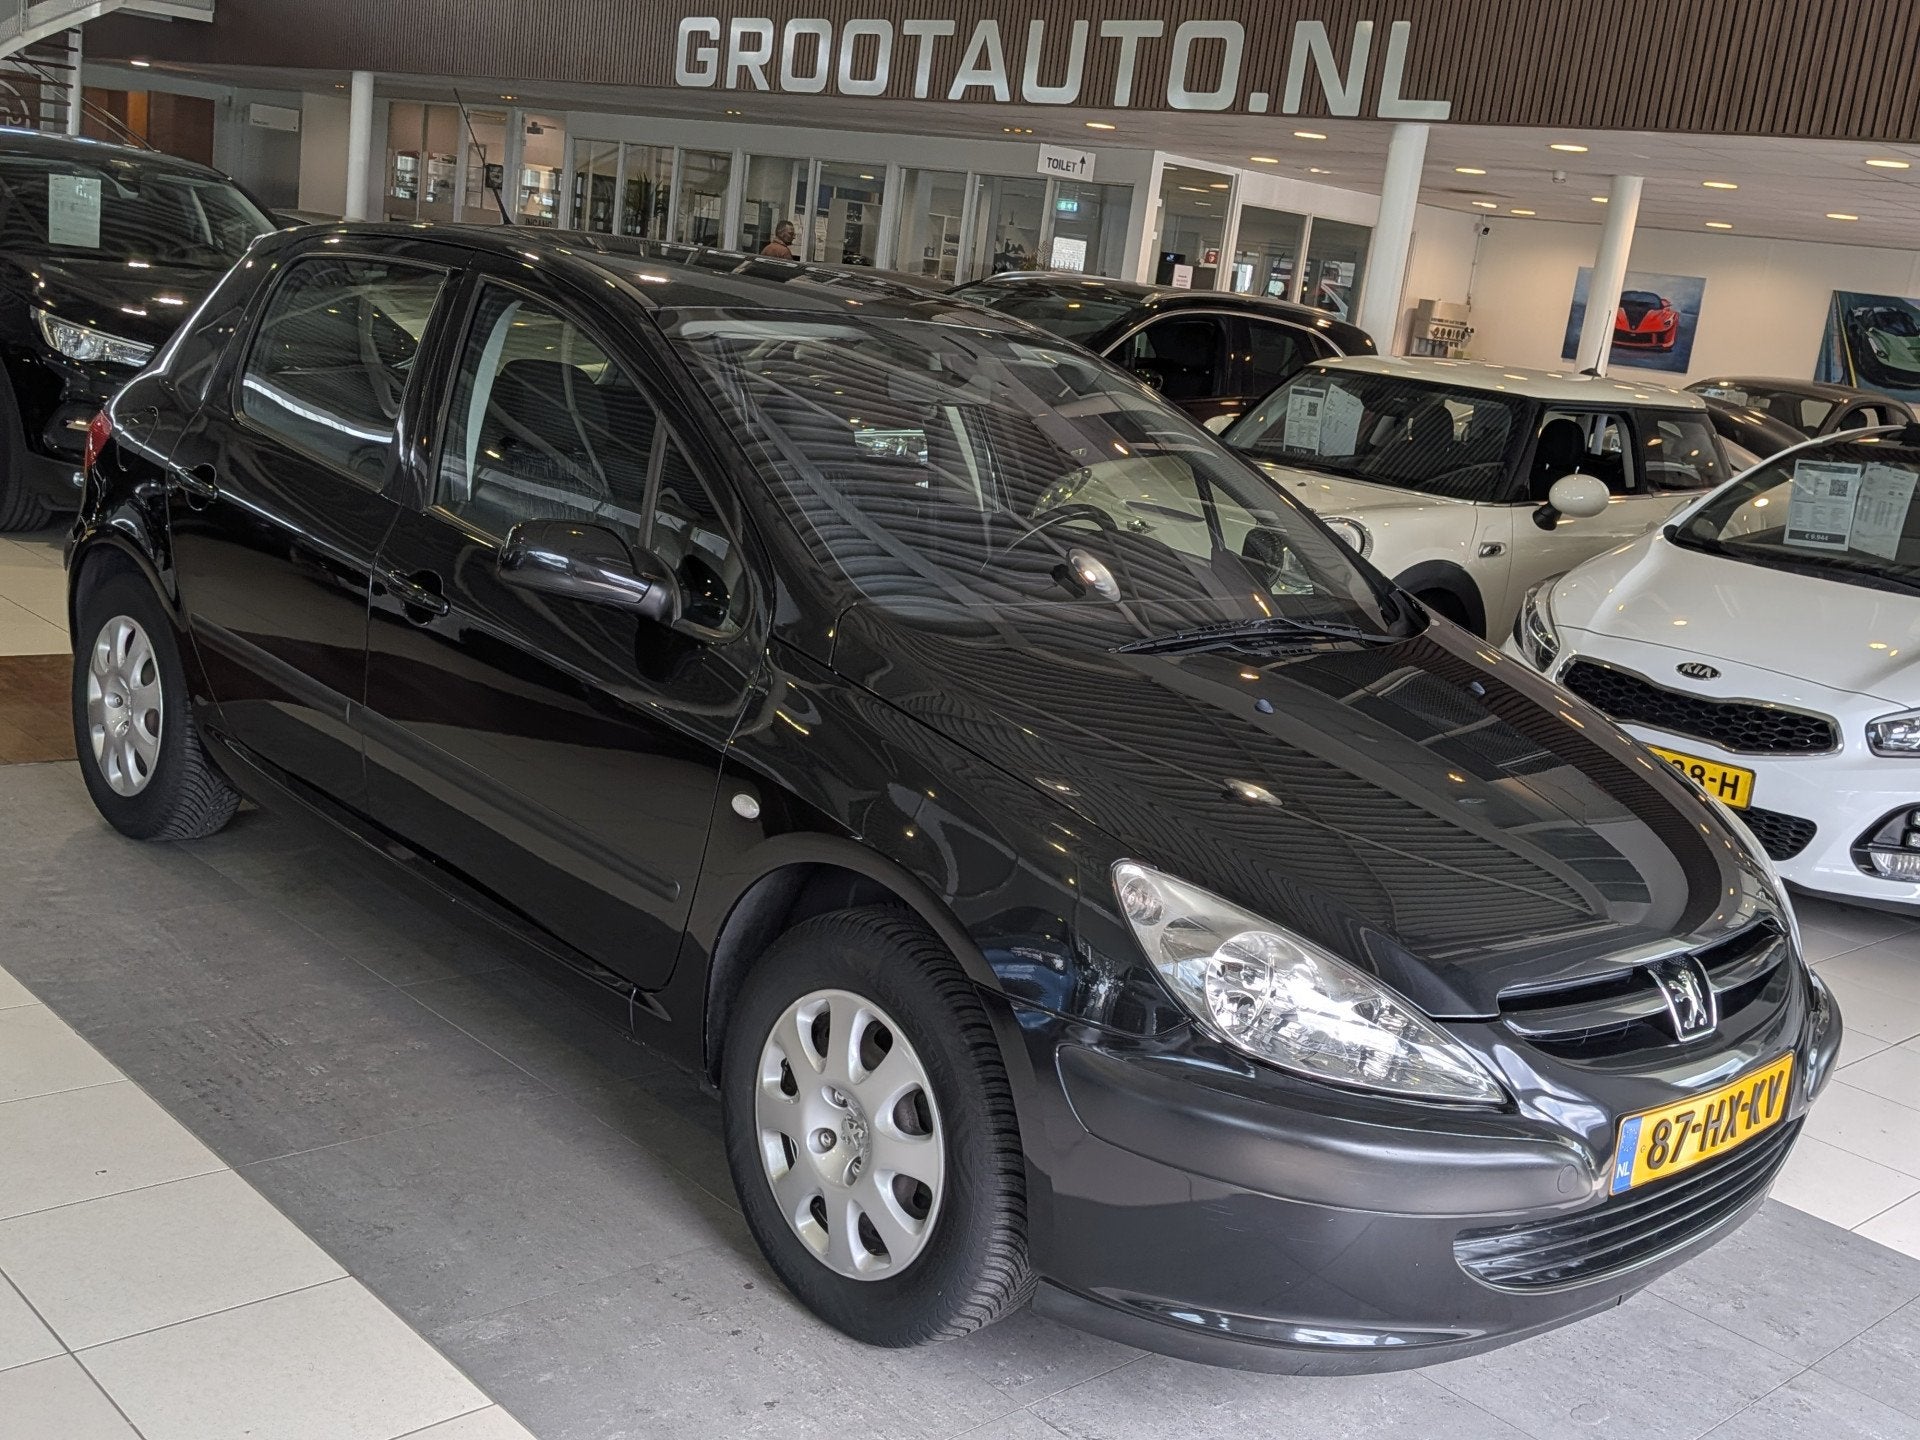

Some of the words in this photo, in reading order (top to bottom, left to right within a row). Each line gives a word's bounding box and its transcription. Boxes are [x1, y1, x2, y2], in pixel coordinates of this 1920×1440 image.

[675, 16, 1451, 120] GROOTAUTO.NL
[1046, 156, 1078, 173] TOILET
[1681, 663, 1713, 678] KIA
[1646, 1069, 1786, 1170] 87-HX-KV
[1616, 1161, 1631, 1179] NL
